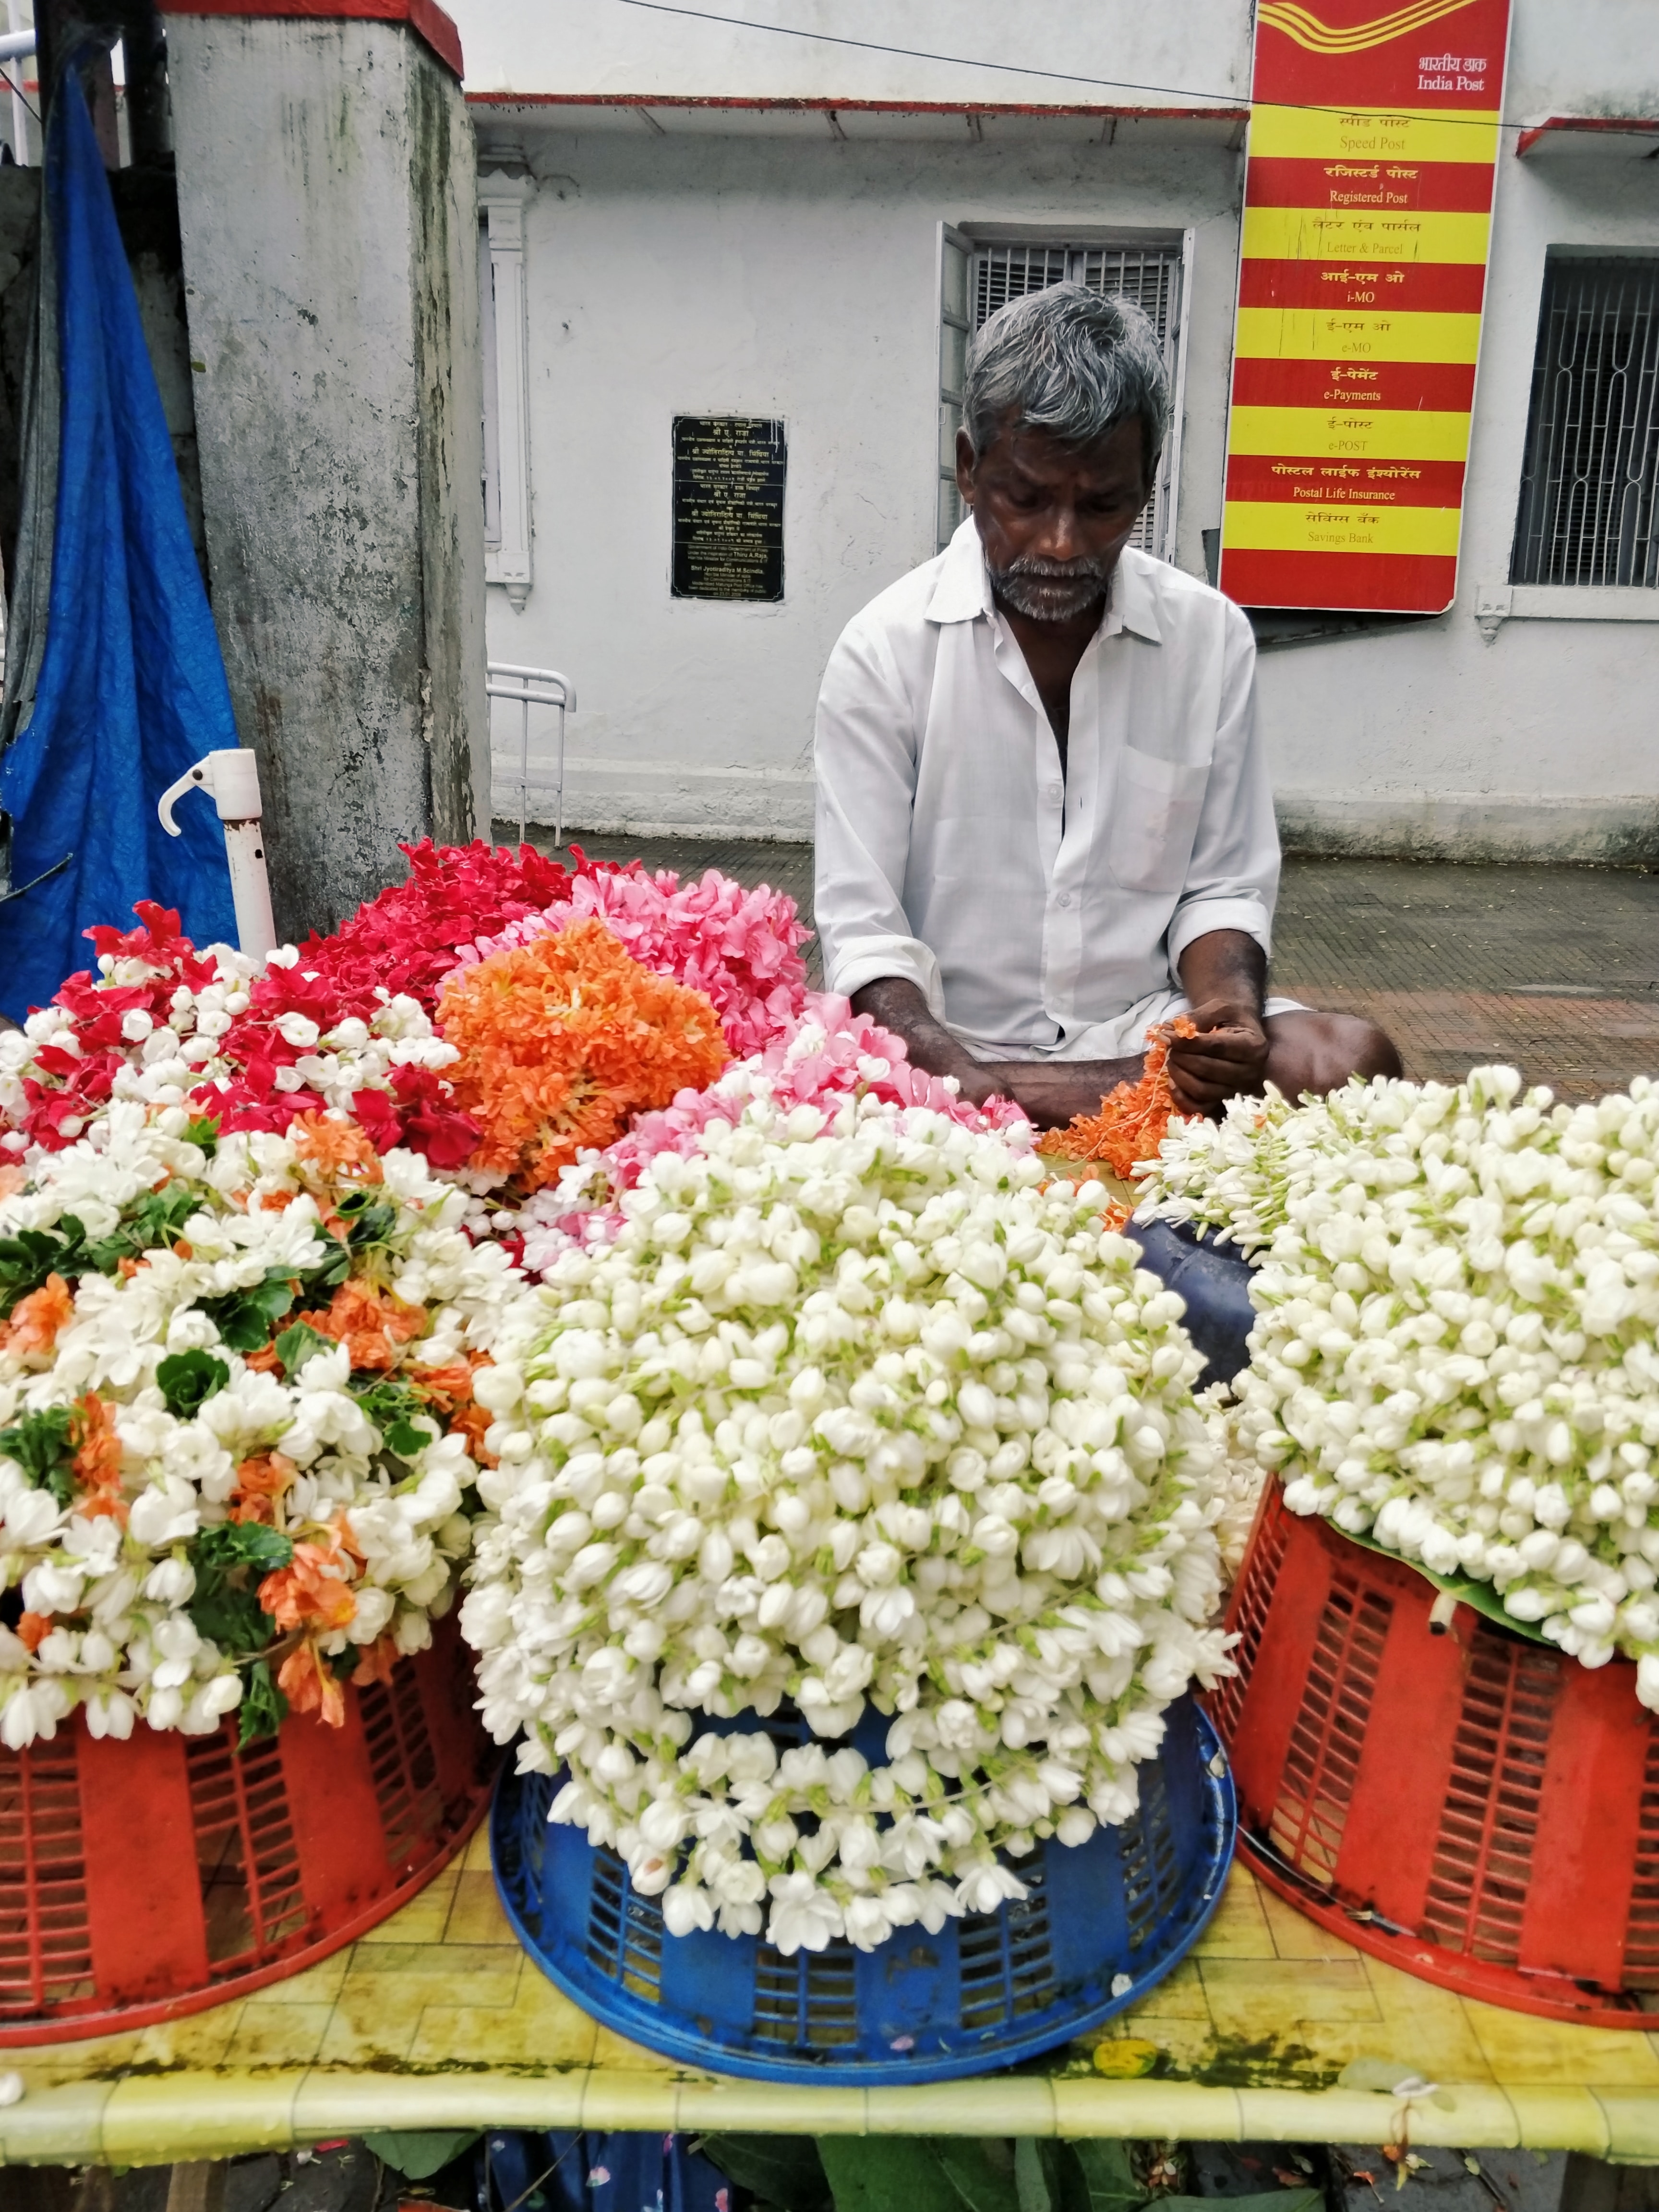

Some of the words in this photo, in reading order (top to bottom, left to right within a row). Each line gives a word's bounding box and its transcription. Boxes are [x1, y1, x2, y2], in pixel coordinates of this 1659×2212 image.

[1418, 53, 1462, 72] भारतीय
[1463, 57, 1487, 72] डाक
[1417, 75, 1453, 90] India
[1456, 76, 1484, 90] Post
[1340, 136, 1375, 152] Speed
[1381, 137, 1404, 149] Post
[1323, 165, 1379, 178] रजिस्टर्ड
[1386, 166, 1418, 179] पोस्ट
[1330, 190, 1382, 204] Registered
[1386, 192, 1407, 203] Post
[1382, 219, 1421, 231] पार्सल
[1328, 242, 1356, 252] Letter
[1359, 243, 1368, 253] &
[1372, 243, 1402, 254] Parcel
[1321, 269, 1379, 284] आई-एम
[1385, 271, 1405, 283] ओ
[1347, 291, 1374, 302] i-MO
[1326, 318, 1365, 333] ई-एम
[1374, 321, 1391, 331] ओ
[1342, 343, 1370, 352] e-MO
[1331, 367, 1378, 381] ई-पेमेंट
[1324, 389, 1381, 402] e-Payments
[1327, 417, 1373, 429] ई-पोस्ट
[1329, 441, 1368, 450] e-POST
[1271, 463, 1314, 475] पोस्टल
[1320, 465, 1360, 478] लाईफ
[1366, 467, 1421, 479] इंश्योरेंस
[1293, 487, 1322, 497] Postal
[1326, 488, 1346, 498] Life
[1349, 489, 1395, 500] Insurance
[1308, 532, 1345, 544] Savings
[1349, 533, 1373, 543] Bank
